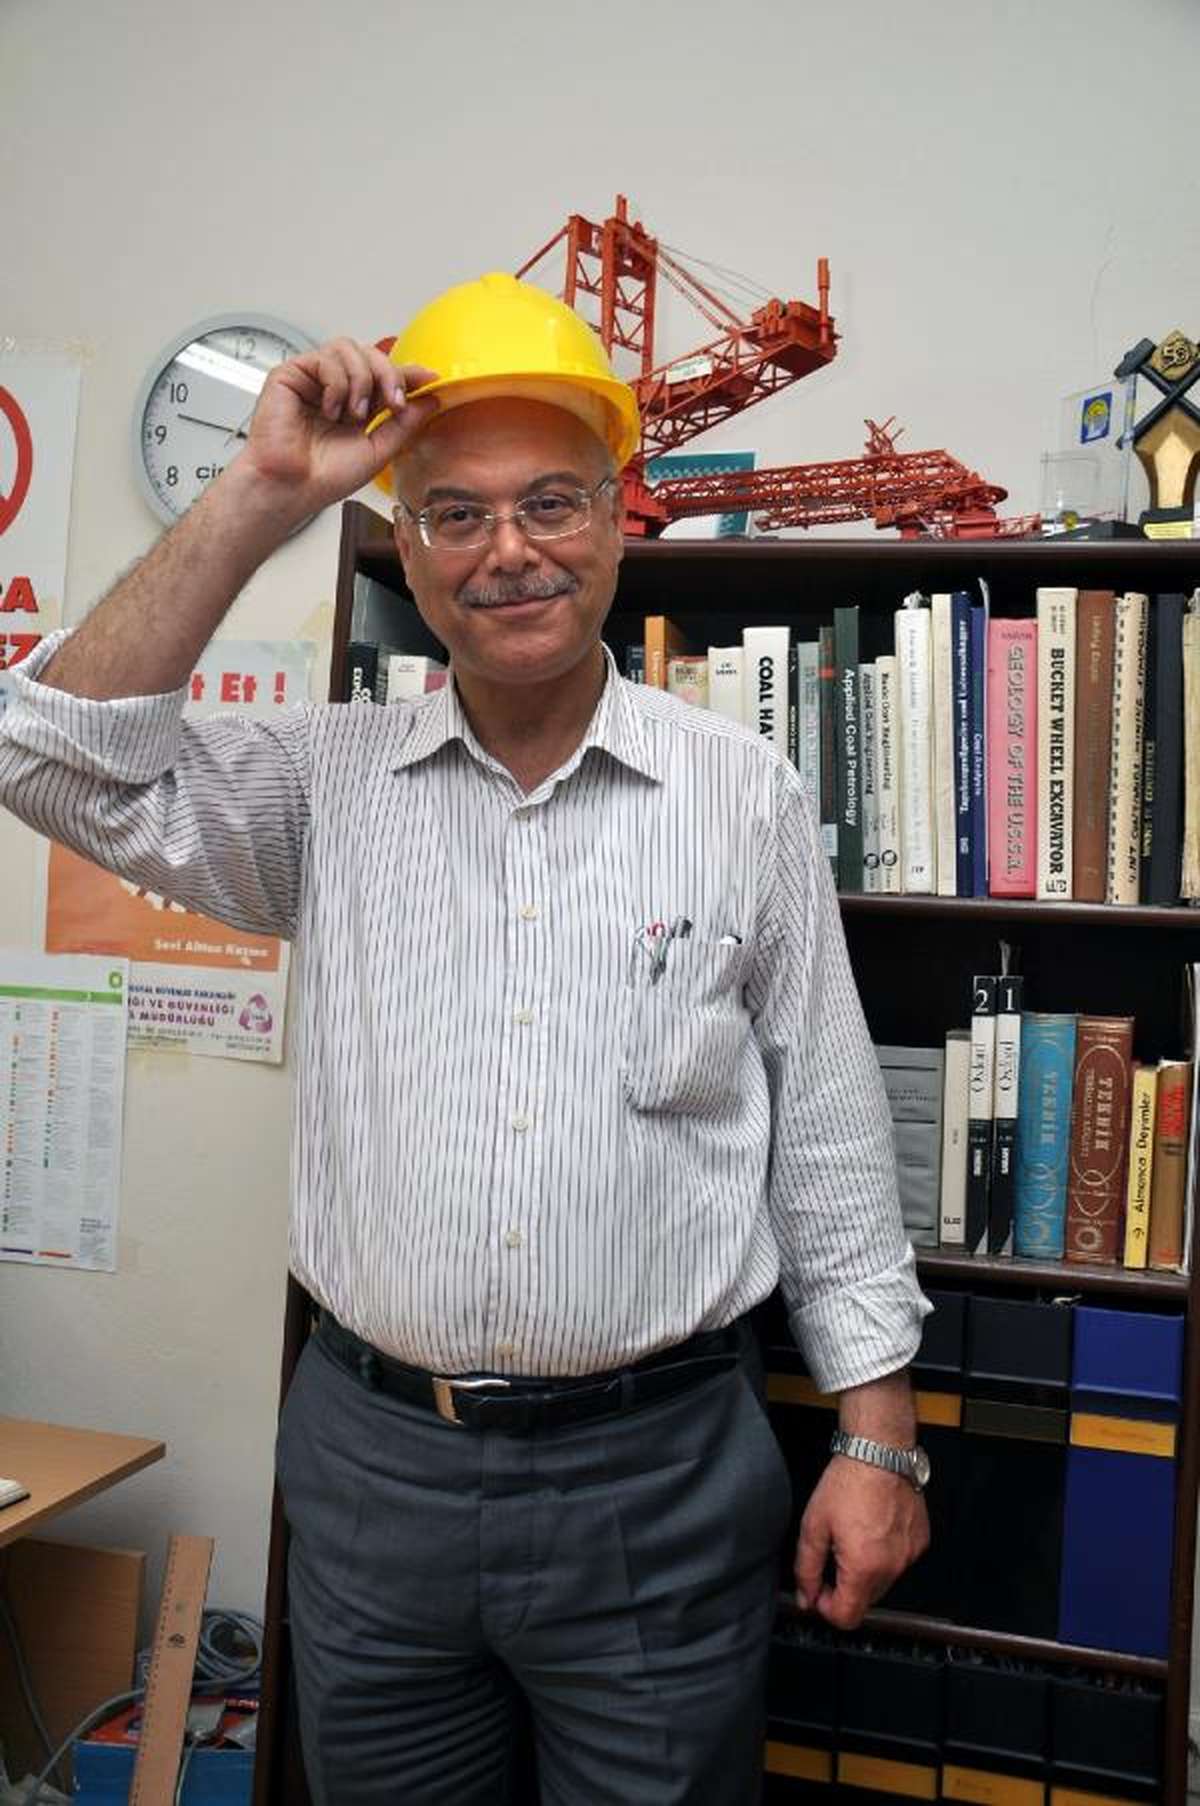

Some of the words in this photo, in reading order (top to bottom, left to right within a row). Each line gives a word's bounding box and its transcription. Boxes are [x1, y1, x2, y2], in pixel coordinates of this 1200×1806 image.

[235, 338, 257, 361] 12
[169, 383, 190, 404] 10
[154, 425, 168, 446] 9
[166, 465, 180, 487] 8
[0, 576, 39, 612] A
[221, 673, 257, 703] Et
[758, 656, 774, 703] COAL
[842, 668, 856, 721] Applied
[1008, 643, 1026, 739] GEOLOGY
[1050, 648, 1065, 713] BUCKET
[844, 727, 857, 757] Coal
[1008, 745, 1025, 768] OF
[1050, 717, 1065, 775] WHEEL
[845, 759, 857, 827] Petrology
[1008, 773, 1025, 807] THE
[1049, 779, 1066, 875] EXCAVATOR
[975, 988, 990, 1013] 2
[1005, 988, 1015, 1012] 1
[1136, 1090, 1151, 1149] Deyimler
[1133, 1157, 1146, 1214] Almanca
